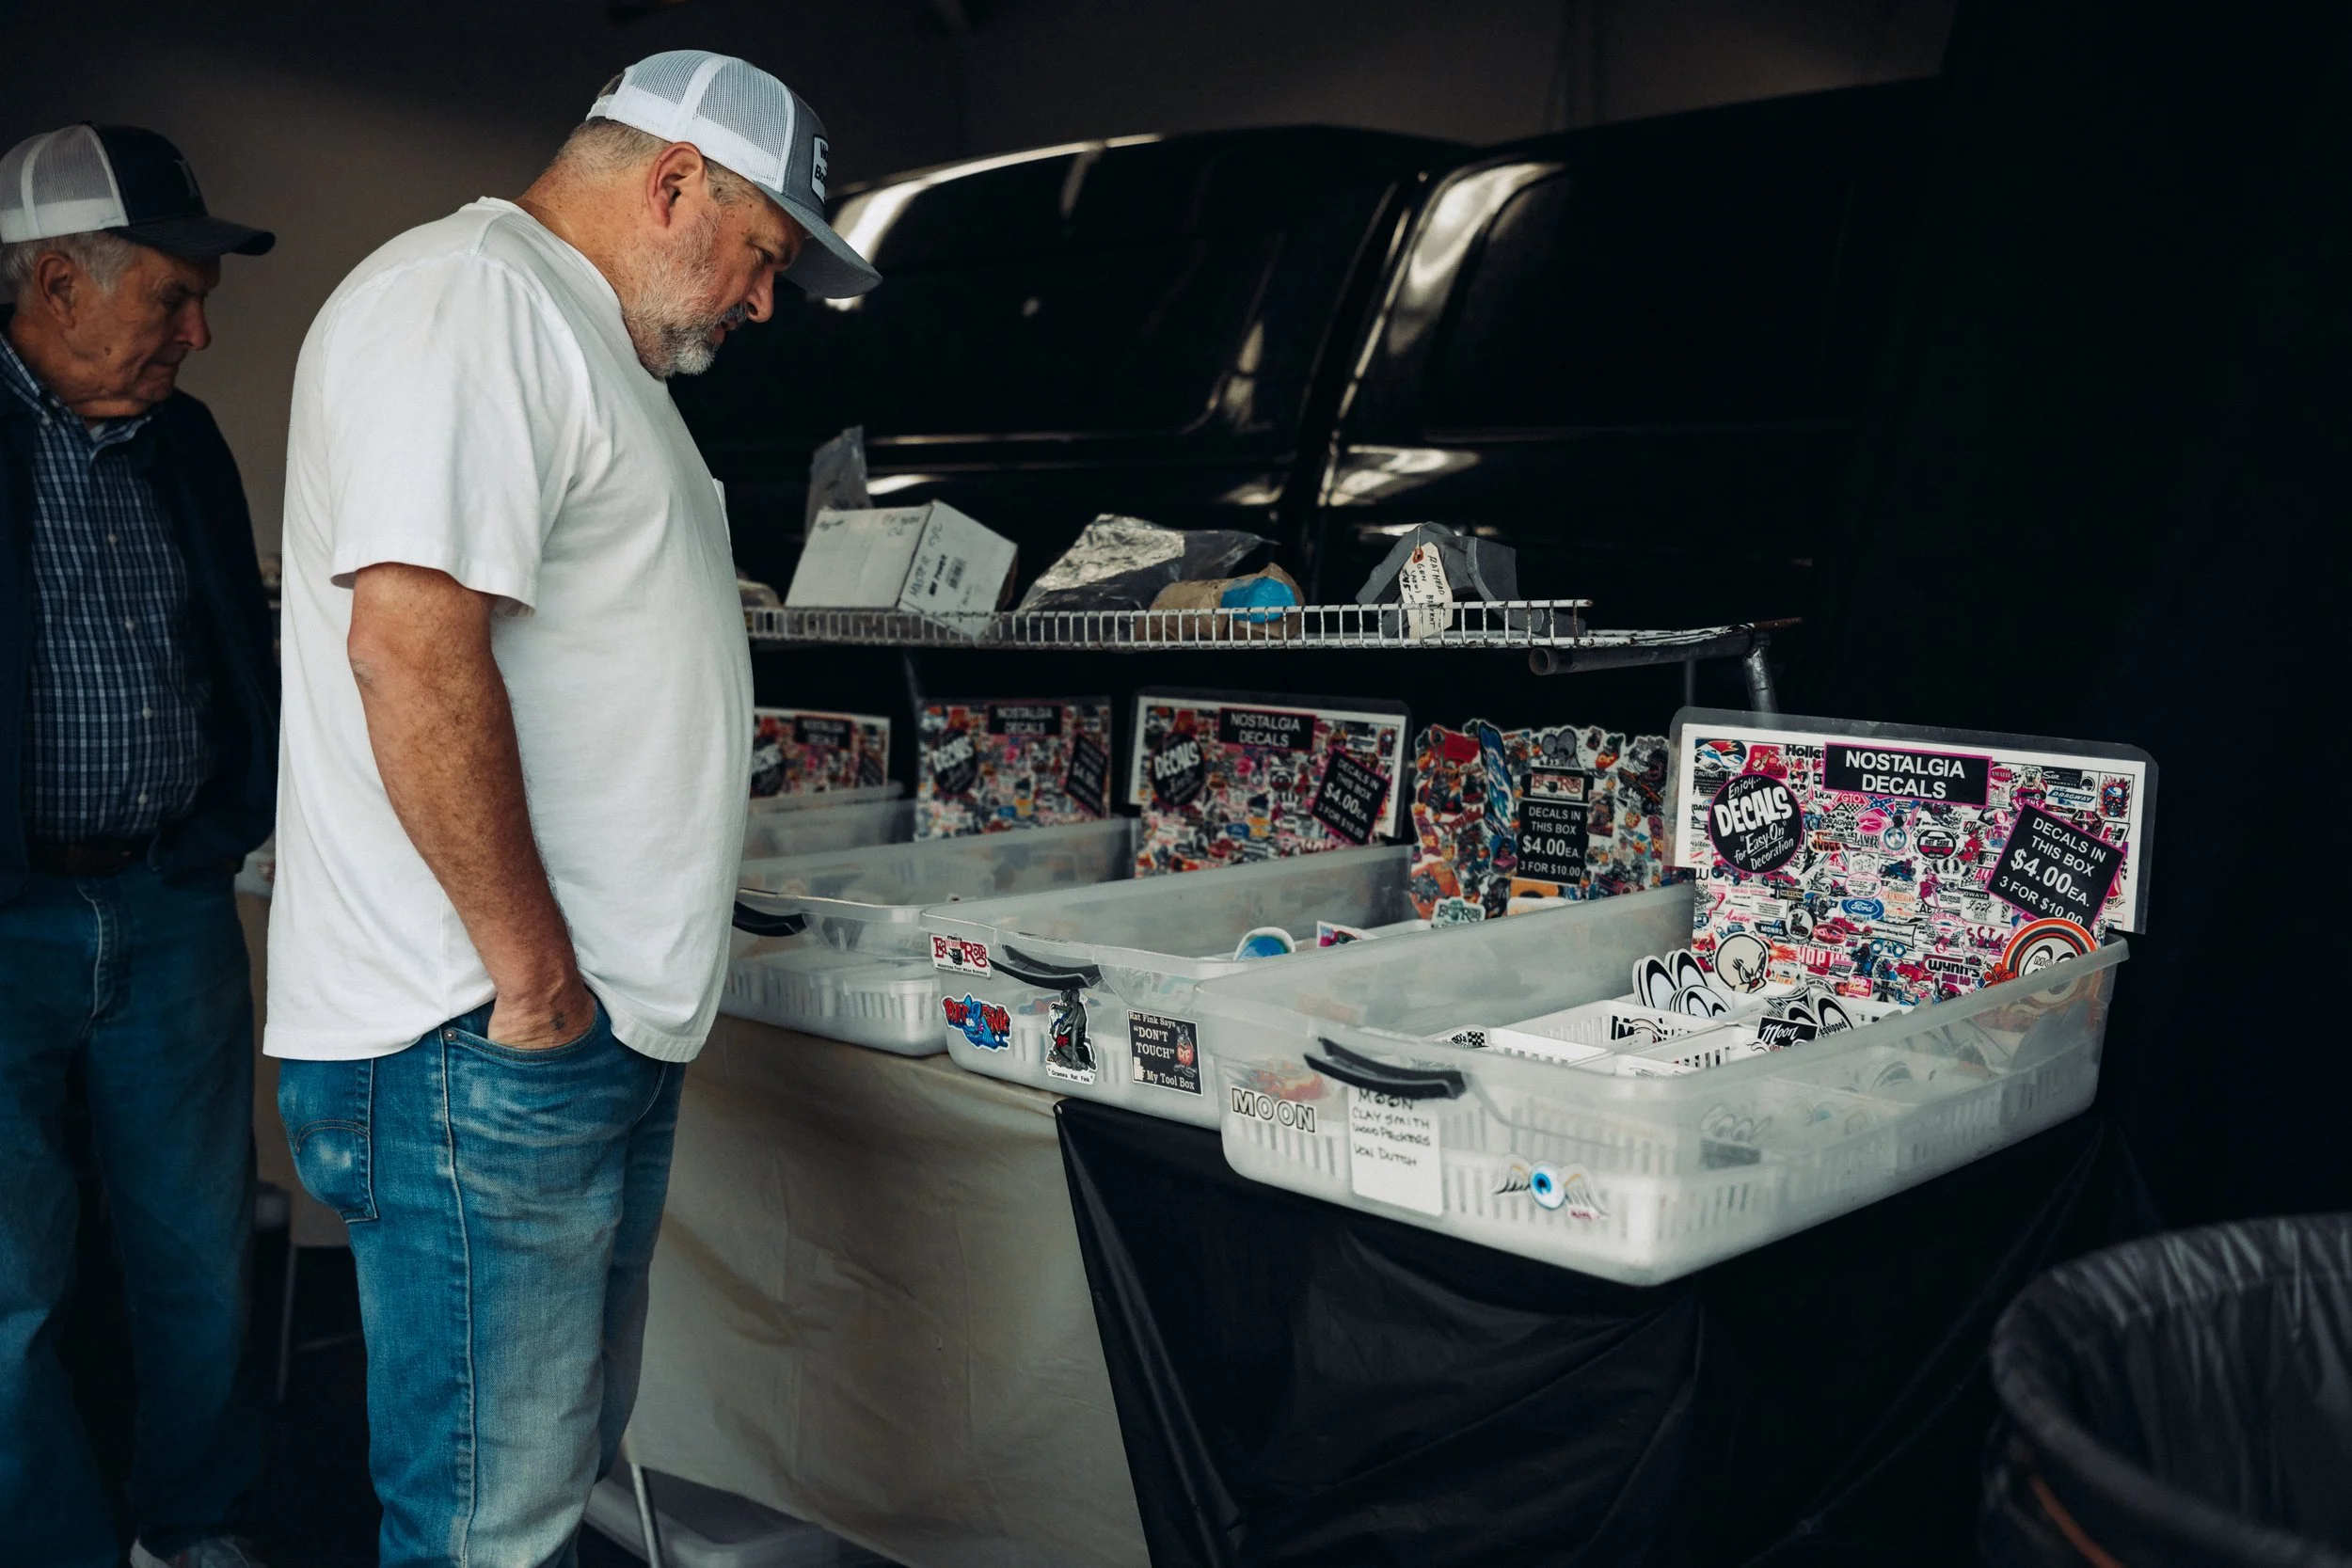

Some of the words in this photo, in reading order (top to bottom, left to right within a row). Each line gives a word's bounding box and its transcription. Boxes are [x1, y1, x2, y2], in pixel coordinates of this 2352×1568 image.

[1230, 713, 1301, 732] NOSTALGIA
[1239, 730, 1290, 748] DECALS
[1337, 758, 1370, 784] DECALS
[1369, 778, 1380, 791] IN
[1845, 750, 1966, 780] NOSTALGIA
[1336, 769, 1355, 788] THIS
[1861, 773, 1947, 800] DECALS
[1841, 793, 1862, 804] GTO
[2051, 790, 2092, 802] DRAGWAY
[1324, 805, 1340, 823] FOR
[1529, 806, 1569, 820] DECALS
[1570, 811, 1581, 821] IN
[1713, 786, 1793, 837] DECALS
[1531, 820, 1552, 833] THIS
[1554, 823, 1577, 836] BOX
[1825, 817, 1856, 828] DRAGWAY
[2032, 817, 2089, 854] DECALS
[2090, 846, 2106, 863] IN
[1733, 848, 1747, 865] for
[1750, 838, 1794, 871] Decoration
[2031, 835, 2061, 860] THIS
[2062, 854, 2096, 878] BOX
[1519, 860, 1526, 870] 3
[1528, 861, 1549, 874] FOR
[1550, 863, 1581, 878] $10.00
[1999, 876, 2010, 889] 3
[2010, 881, 2040, 907] FOR
[1851, 900, 1874, 912] Ford
[1806, 942, 1829, 951] Feature
[1129, 1011, 1141, 1021] Rat
[1142, 1014, 1159, 1024] Fink
[1160, 1017, 1176, 1029] Says
[1761, 1022, 1800, 1045] Moon
[1147, 1069, 1159, 1085] My
[1160, 1072, 1178, 1086] Tool
[1179, 1077, 1196, 1090] Box
[1232, 1087, 1316, 1133] MOON
[1352, 1106, 1381, 1122] CLAY
[1385, 1114, 1430, 1131] SMITH
[1377, 1146, 1418, 1166] DUTCH
